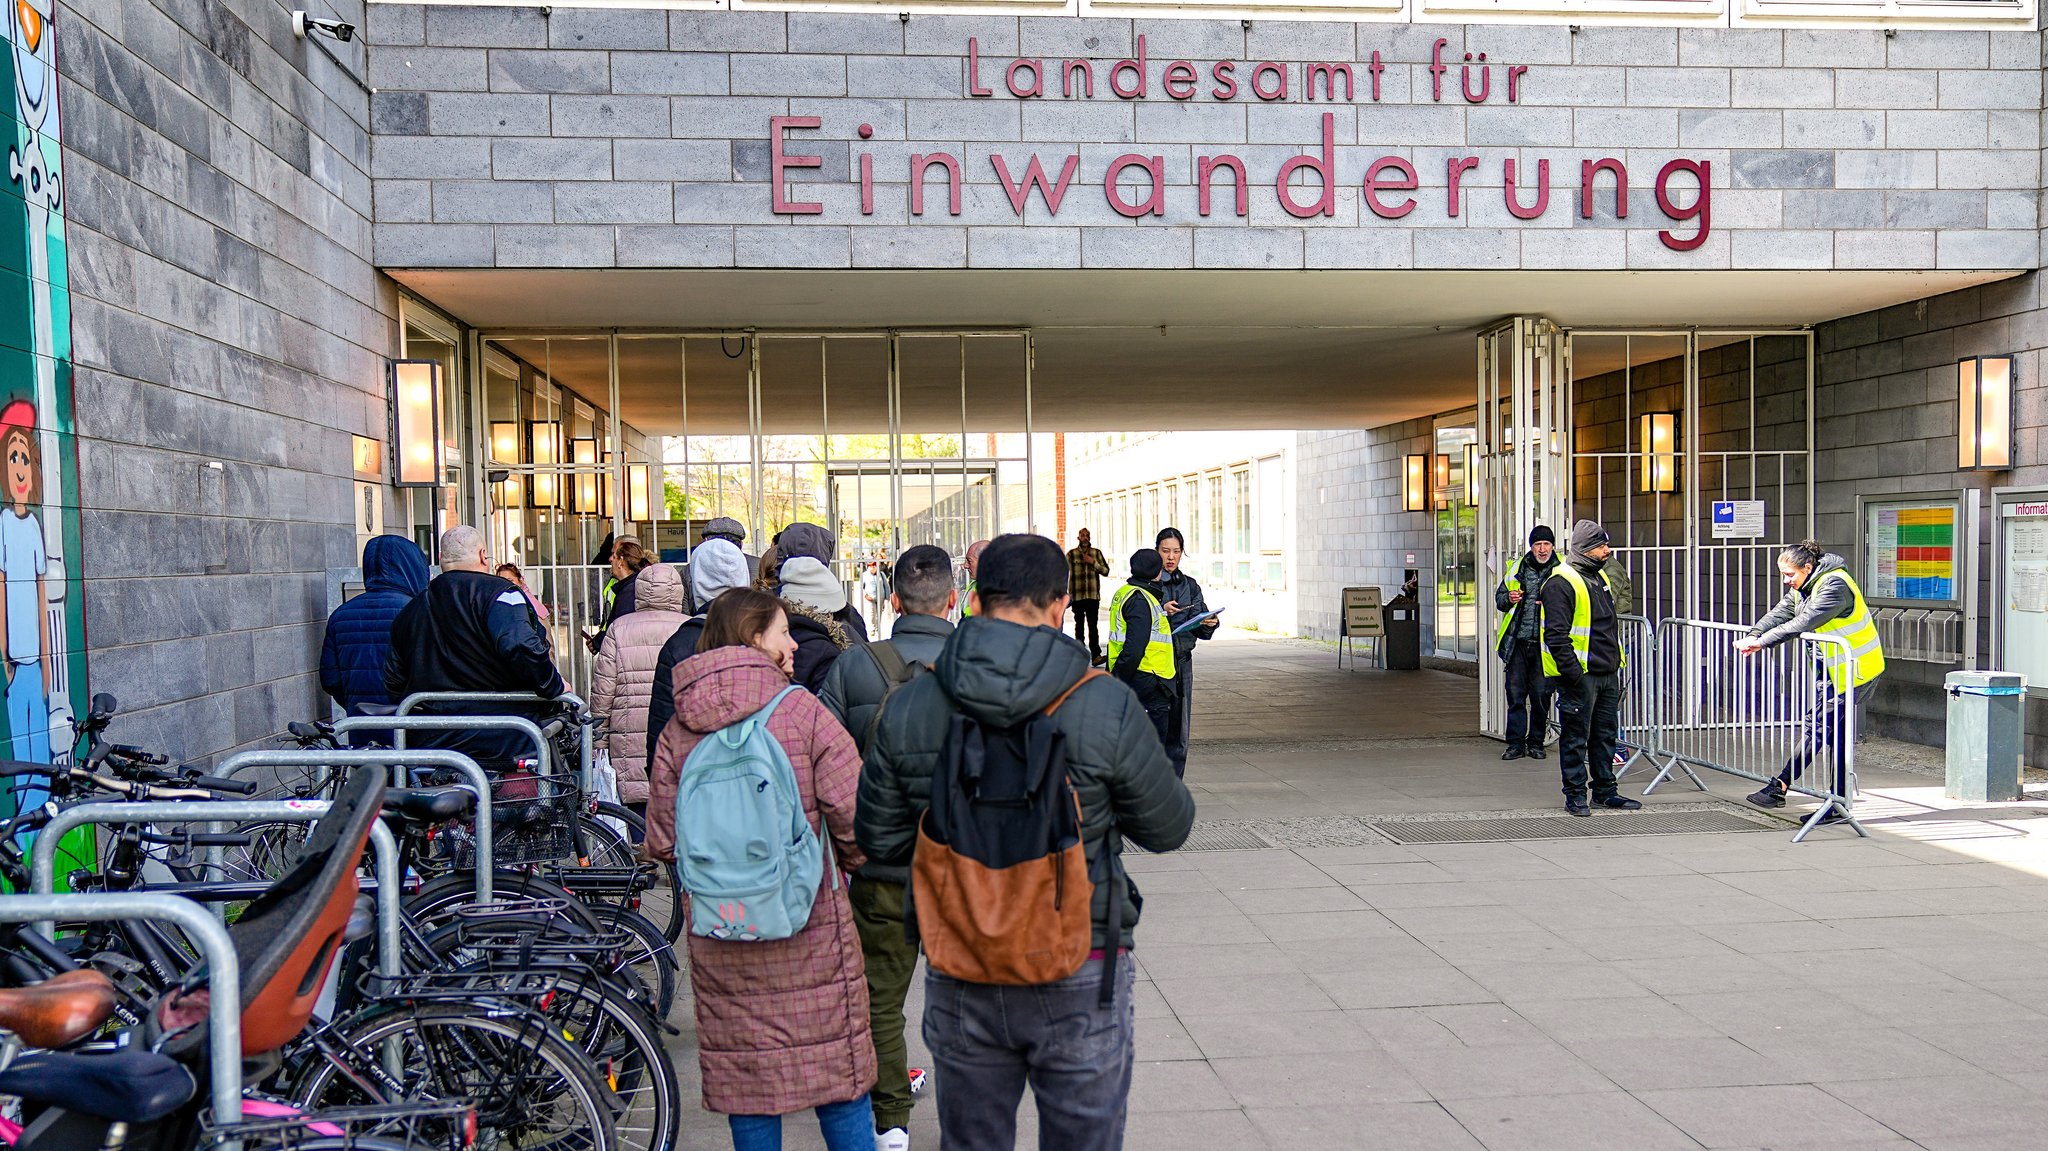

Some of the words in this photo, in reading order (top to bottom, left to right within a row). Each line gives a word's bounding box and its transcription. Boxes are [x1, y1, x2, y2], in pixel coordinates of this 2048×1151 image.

[969, 34, 1384, 101] Landesamt
[1428, 37, 1528, 103] für
[770, 112, 1711, 251] Einwanderung
[667, 528, 685, 536] Haus
